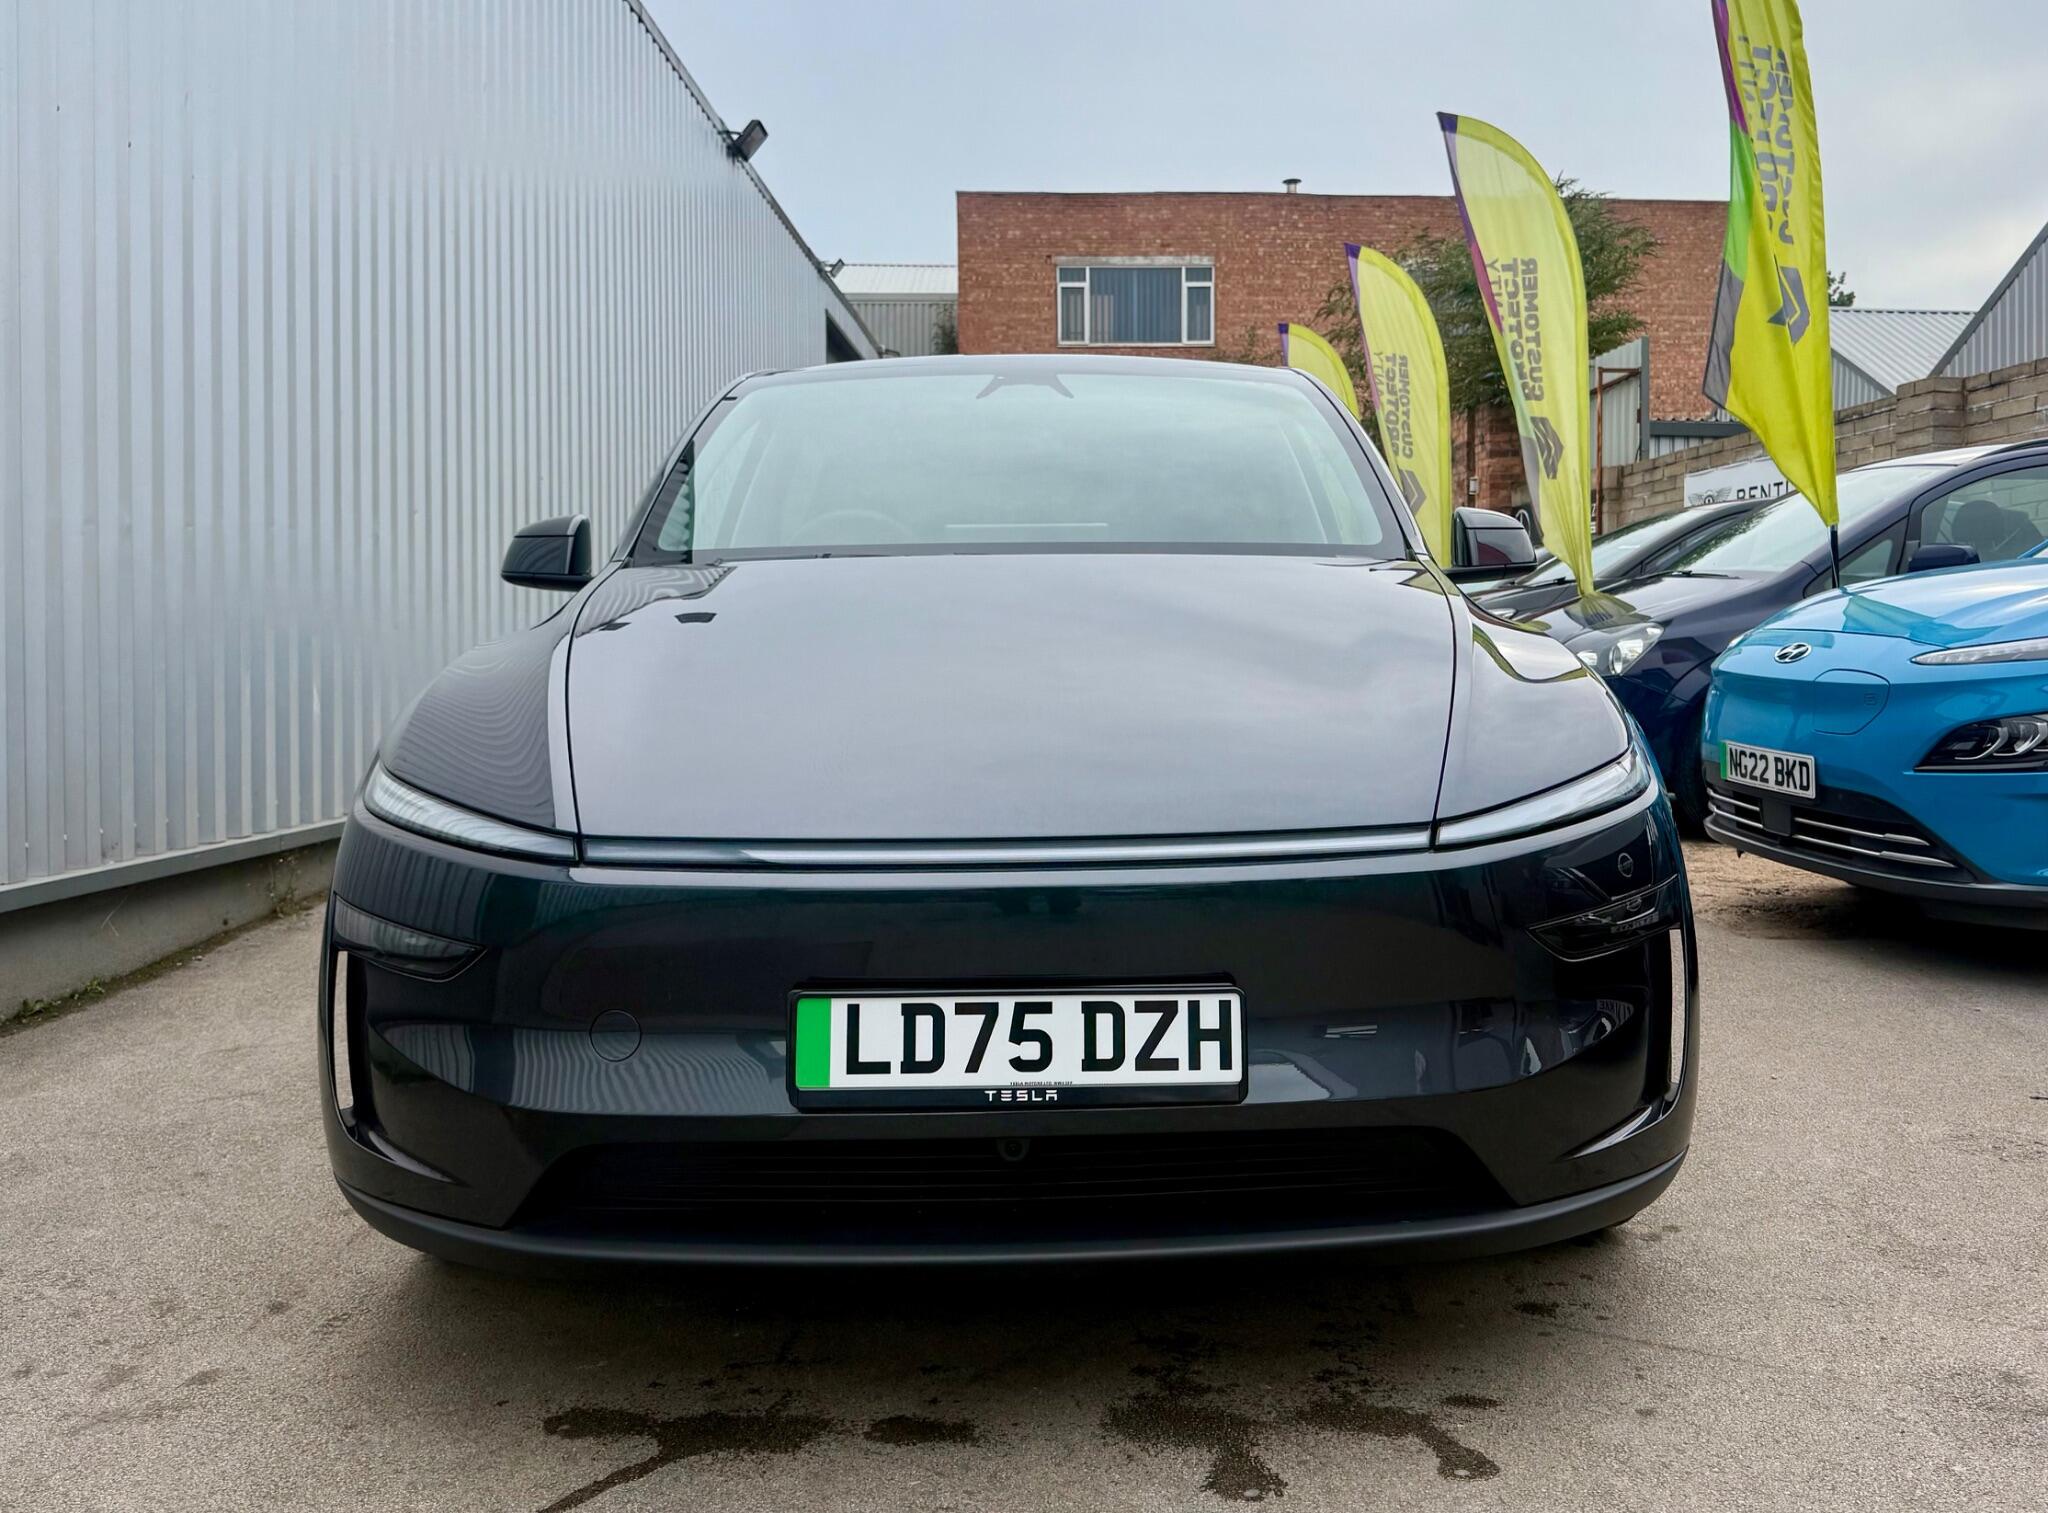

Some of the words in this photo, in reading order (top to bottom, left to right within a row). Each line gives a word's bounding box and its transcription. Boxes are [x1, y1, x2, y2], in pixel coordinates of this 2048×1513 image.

[1729, 747, 1769, 784] NG22
[1774, 757, 1810, 791] BKD
[846, 1001, 1053, 1075] LD75
[1081, 999, 1233, 1073] DZH
[984, 1089, 1058, 1102] TESLA
